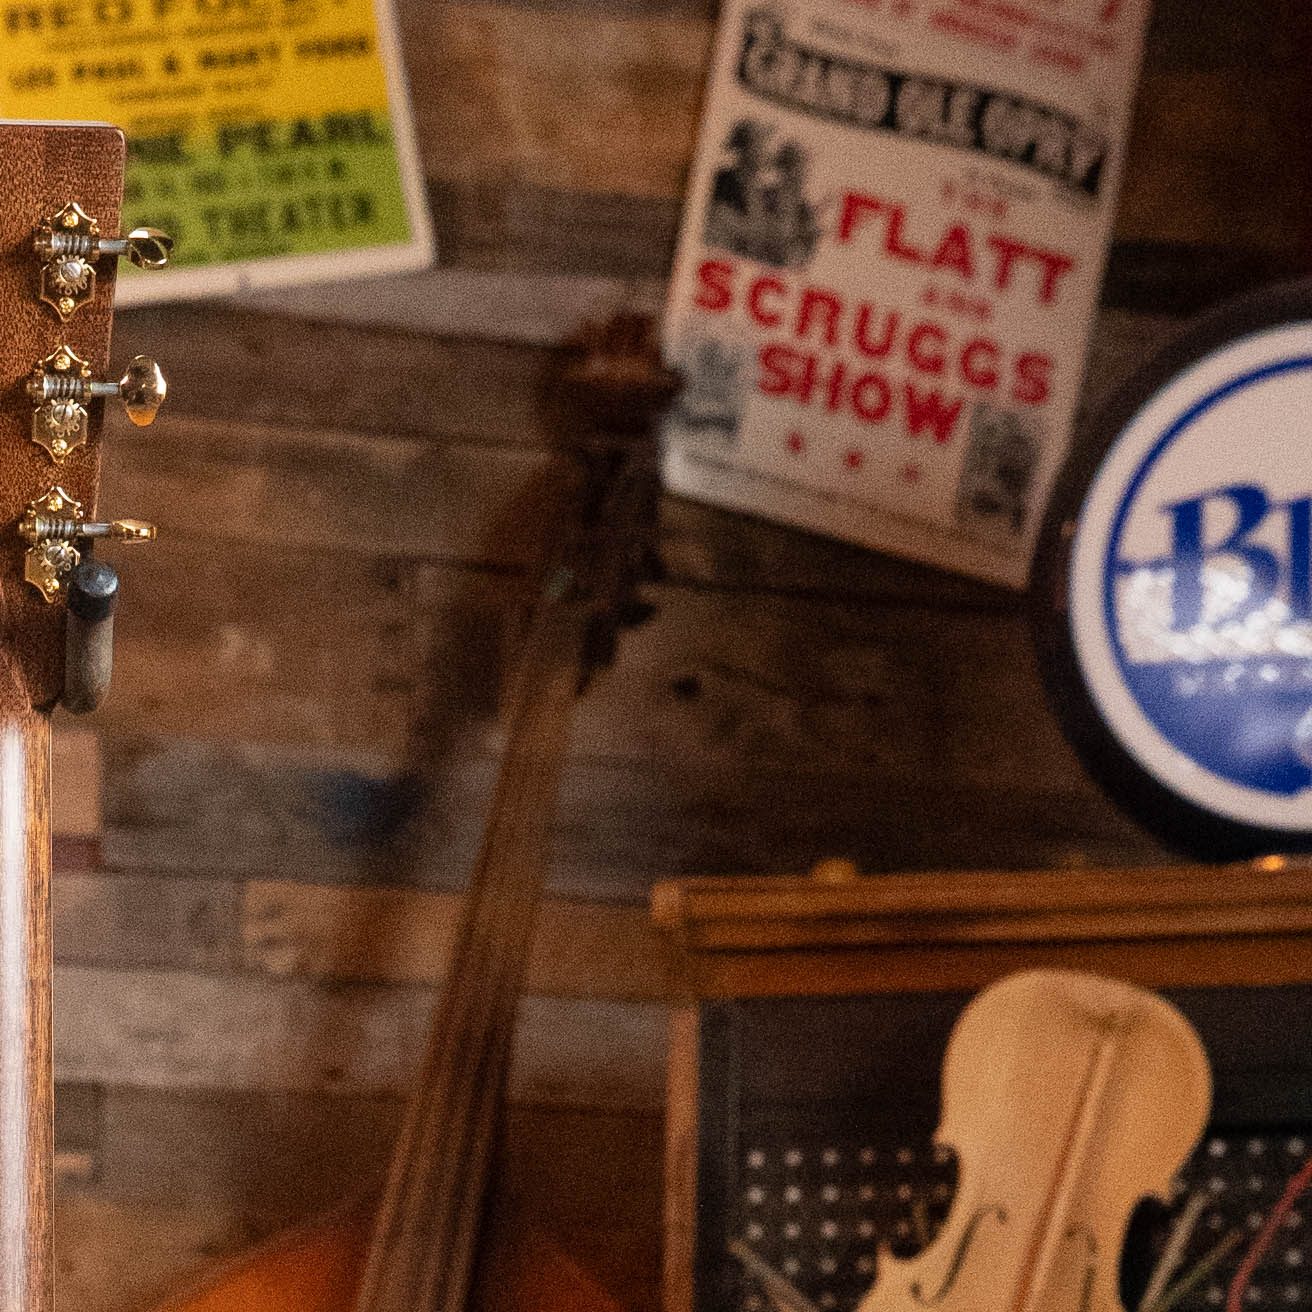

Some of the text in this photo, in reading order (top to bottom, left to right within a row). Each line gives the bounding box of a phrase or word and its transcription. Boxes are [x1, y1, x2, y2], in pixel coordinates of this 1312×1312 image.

[740, 14, 890, 124] GRAND
[895, 76, 978, 147] OLE
[986, 98, 1108, 190] OPRY
[837, 190, 1076, 303] FLATT
[694, 259, 1055, 405] SCRUGGS
[756, 343, 966, 445] SHOW
